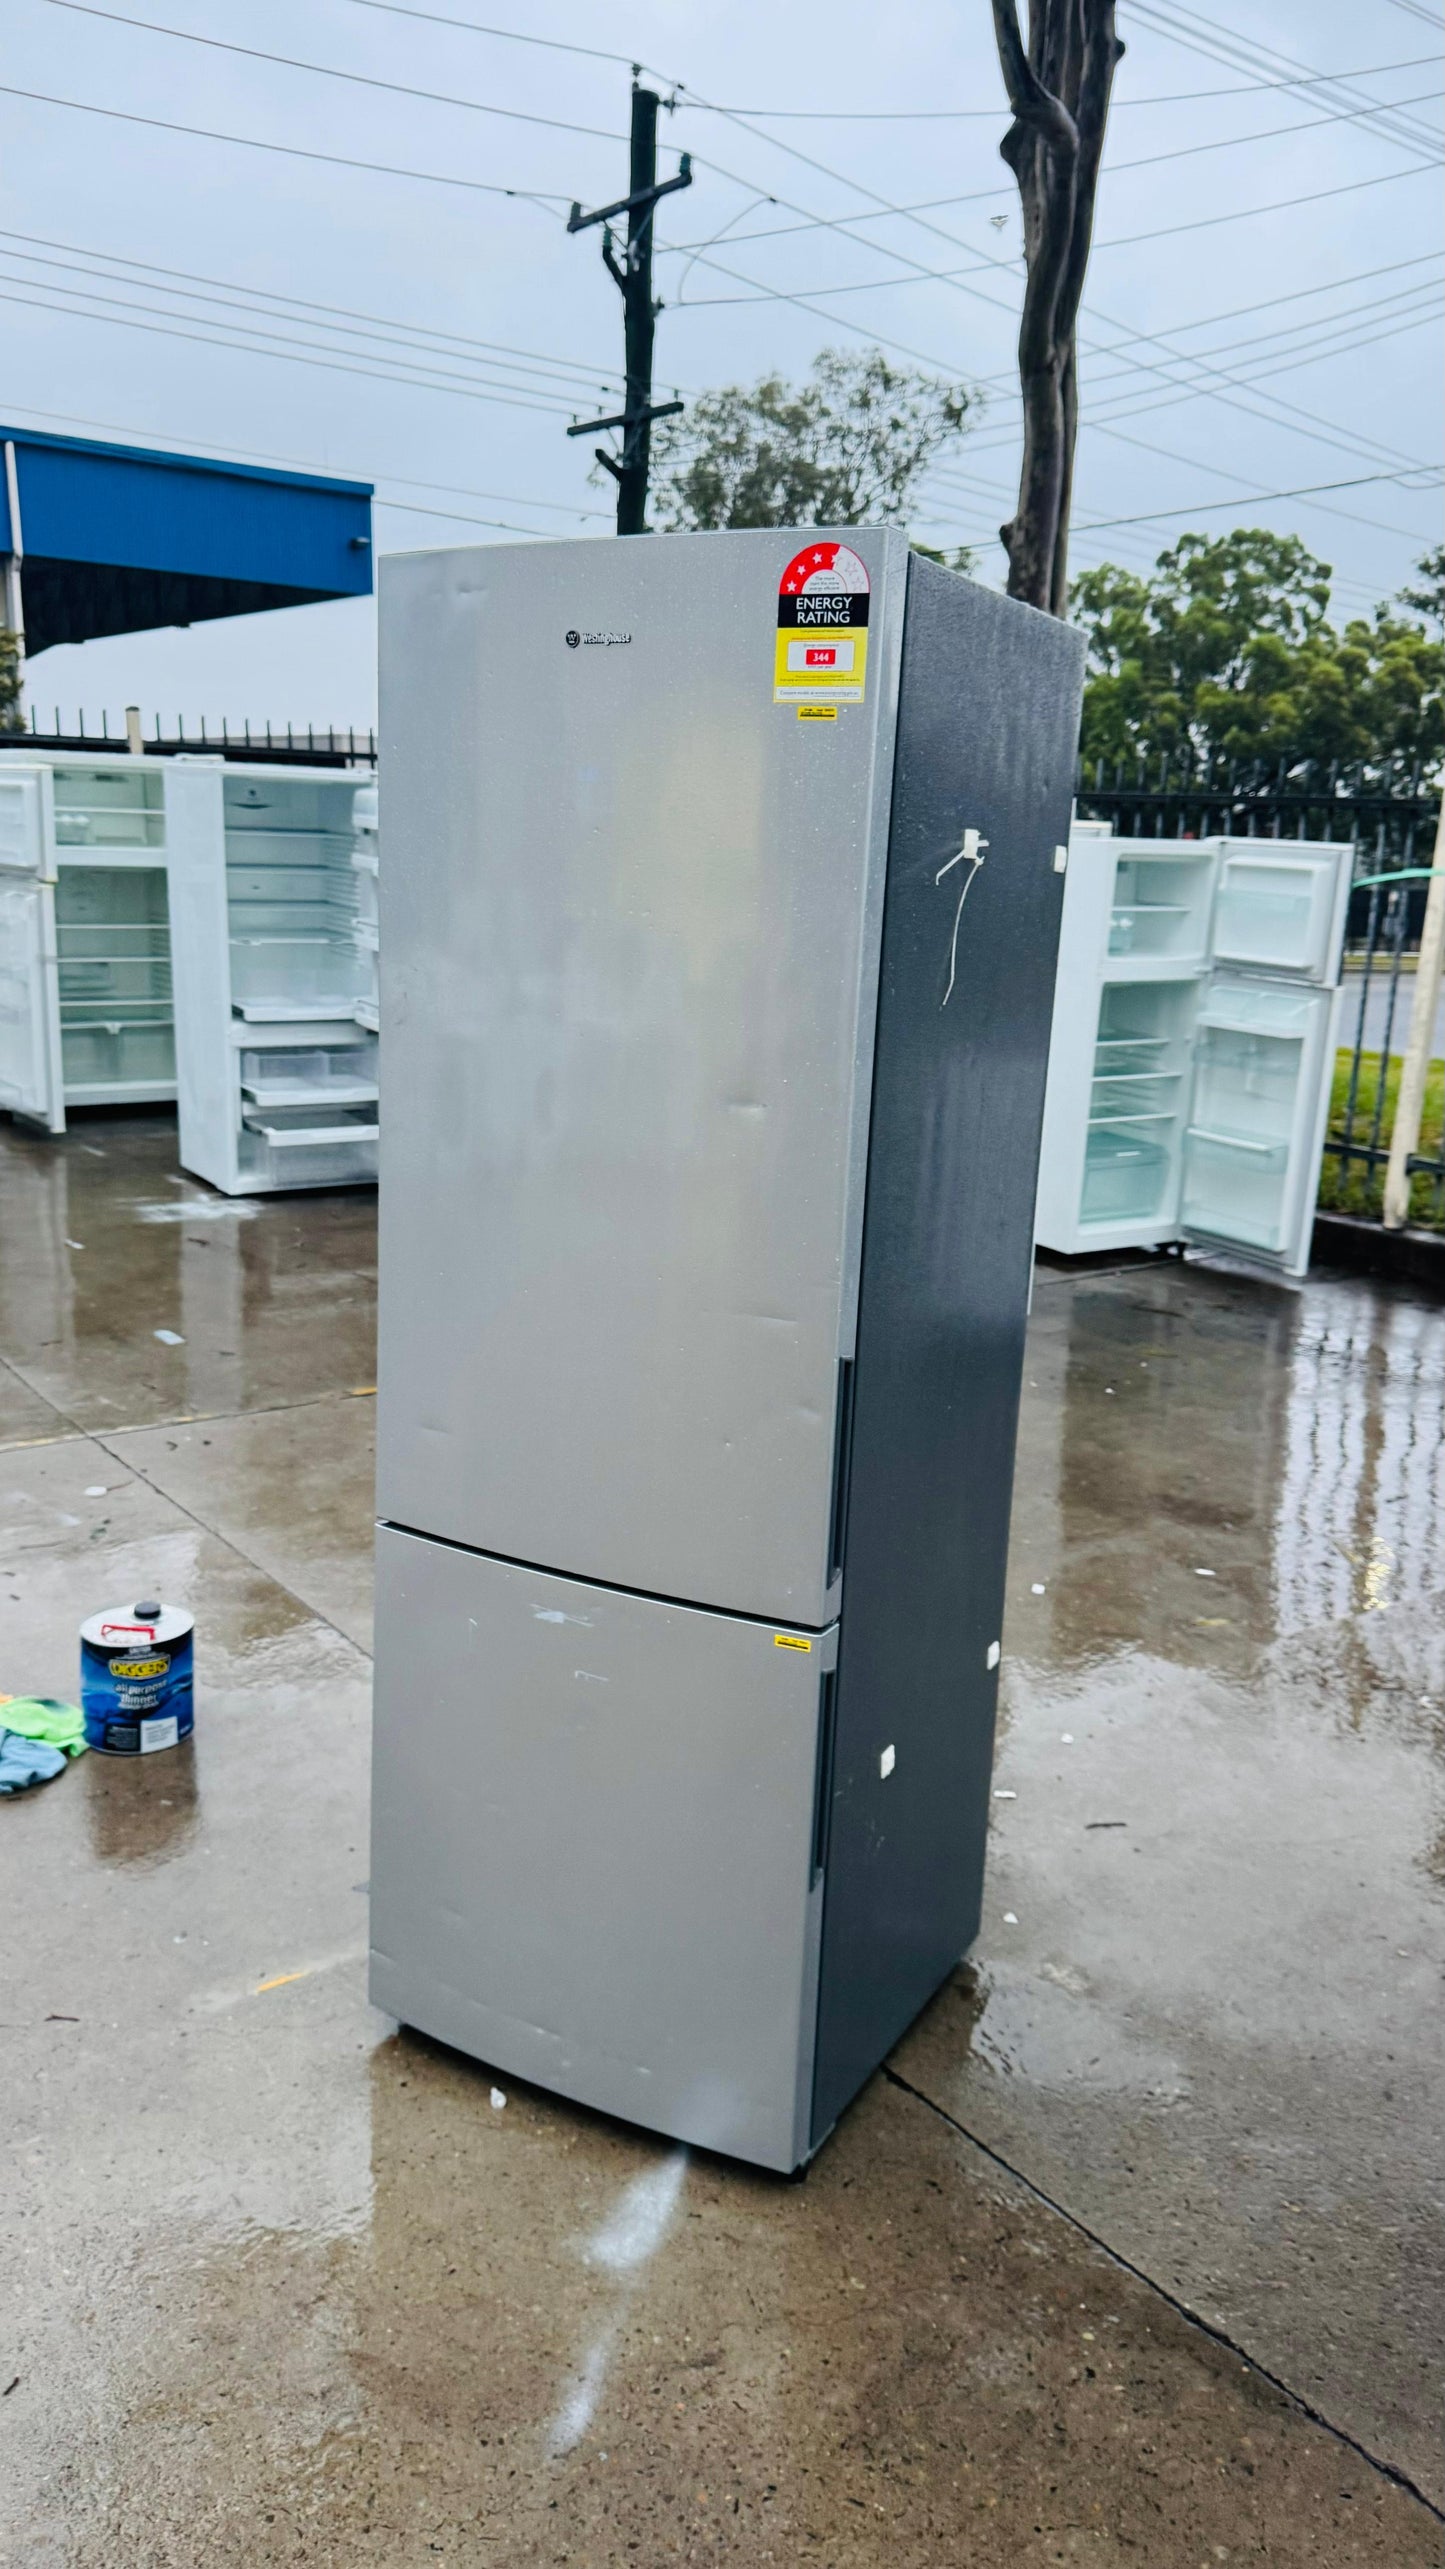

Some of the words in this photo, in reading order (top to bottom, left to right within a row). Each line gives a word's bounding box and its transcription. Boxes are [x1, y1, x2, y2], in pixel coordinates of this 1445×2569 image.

[796, 596, 852, 610] ENERGY
[797, 611, 850, 624] RATING
[813, 652, 830, 662] 344
[111, 1660, 168, 1677] DIGGERS
